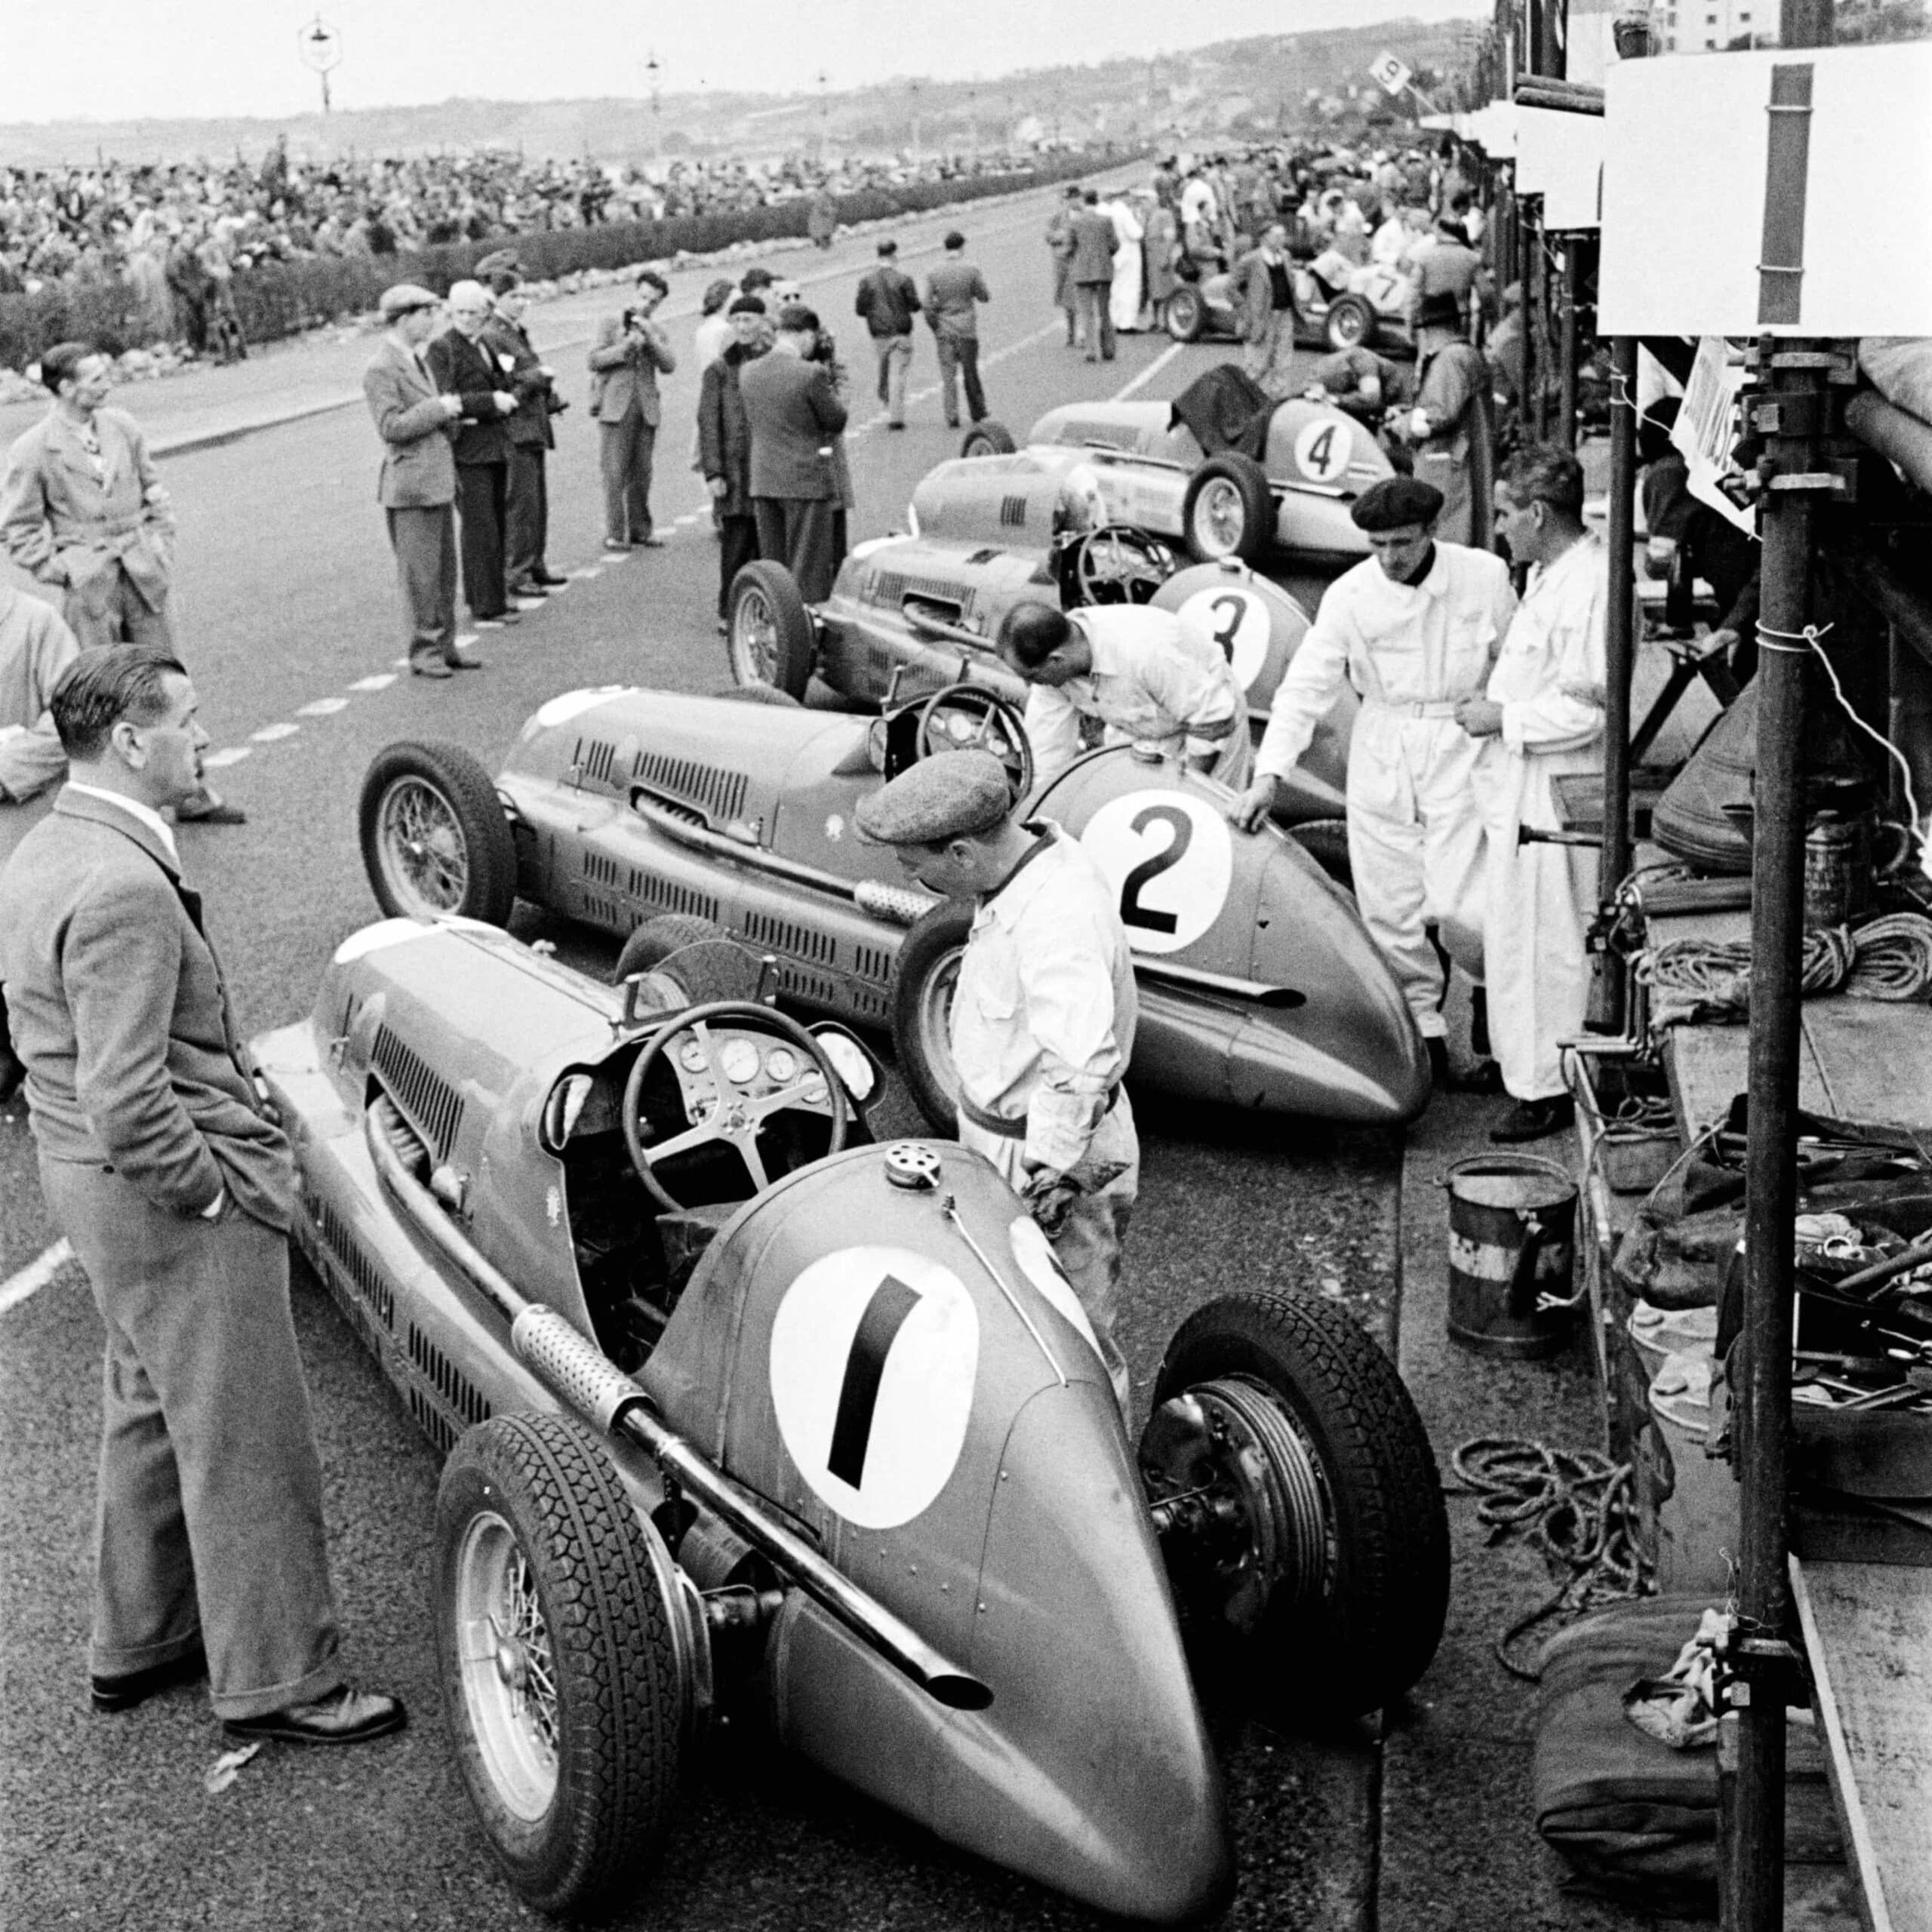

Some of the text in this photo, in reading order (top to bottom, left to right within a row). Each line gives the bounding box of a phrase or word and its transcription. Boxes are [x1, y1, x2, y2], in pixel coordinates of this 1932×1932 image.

[1377, 273, 1398, 302] 7
[1309, 425, 1336, 475] 4
[1211, 595, 1247, 666] 3
[1119, 805, 1193, 935] 2
[827, 1274, 923, 1491] 1
